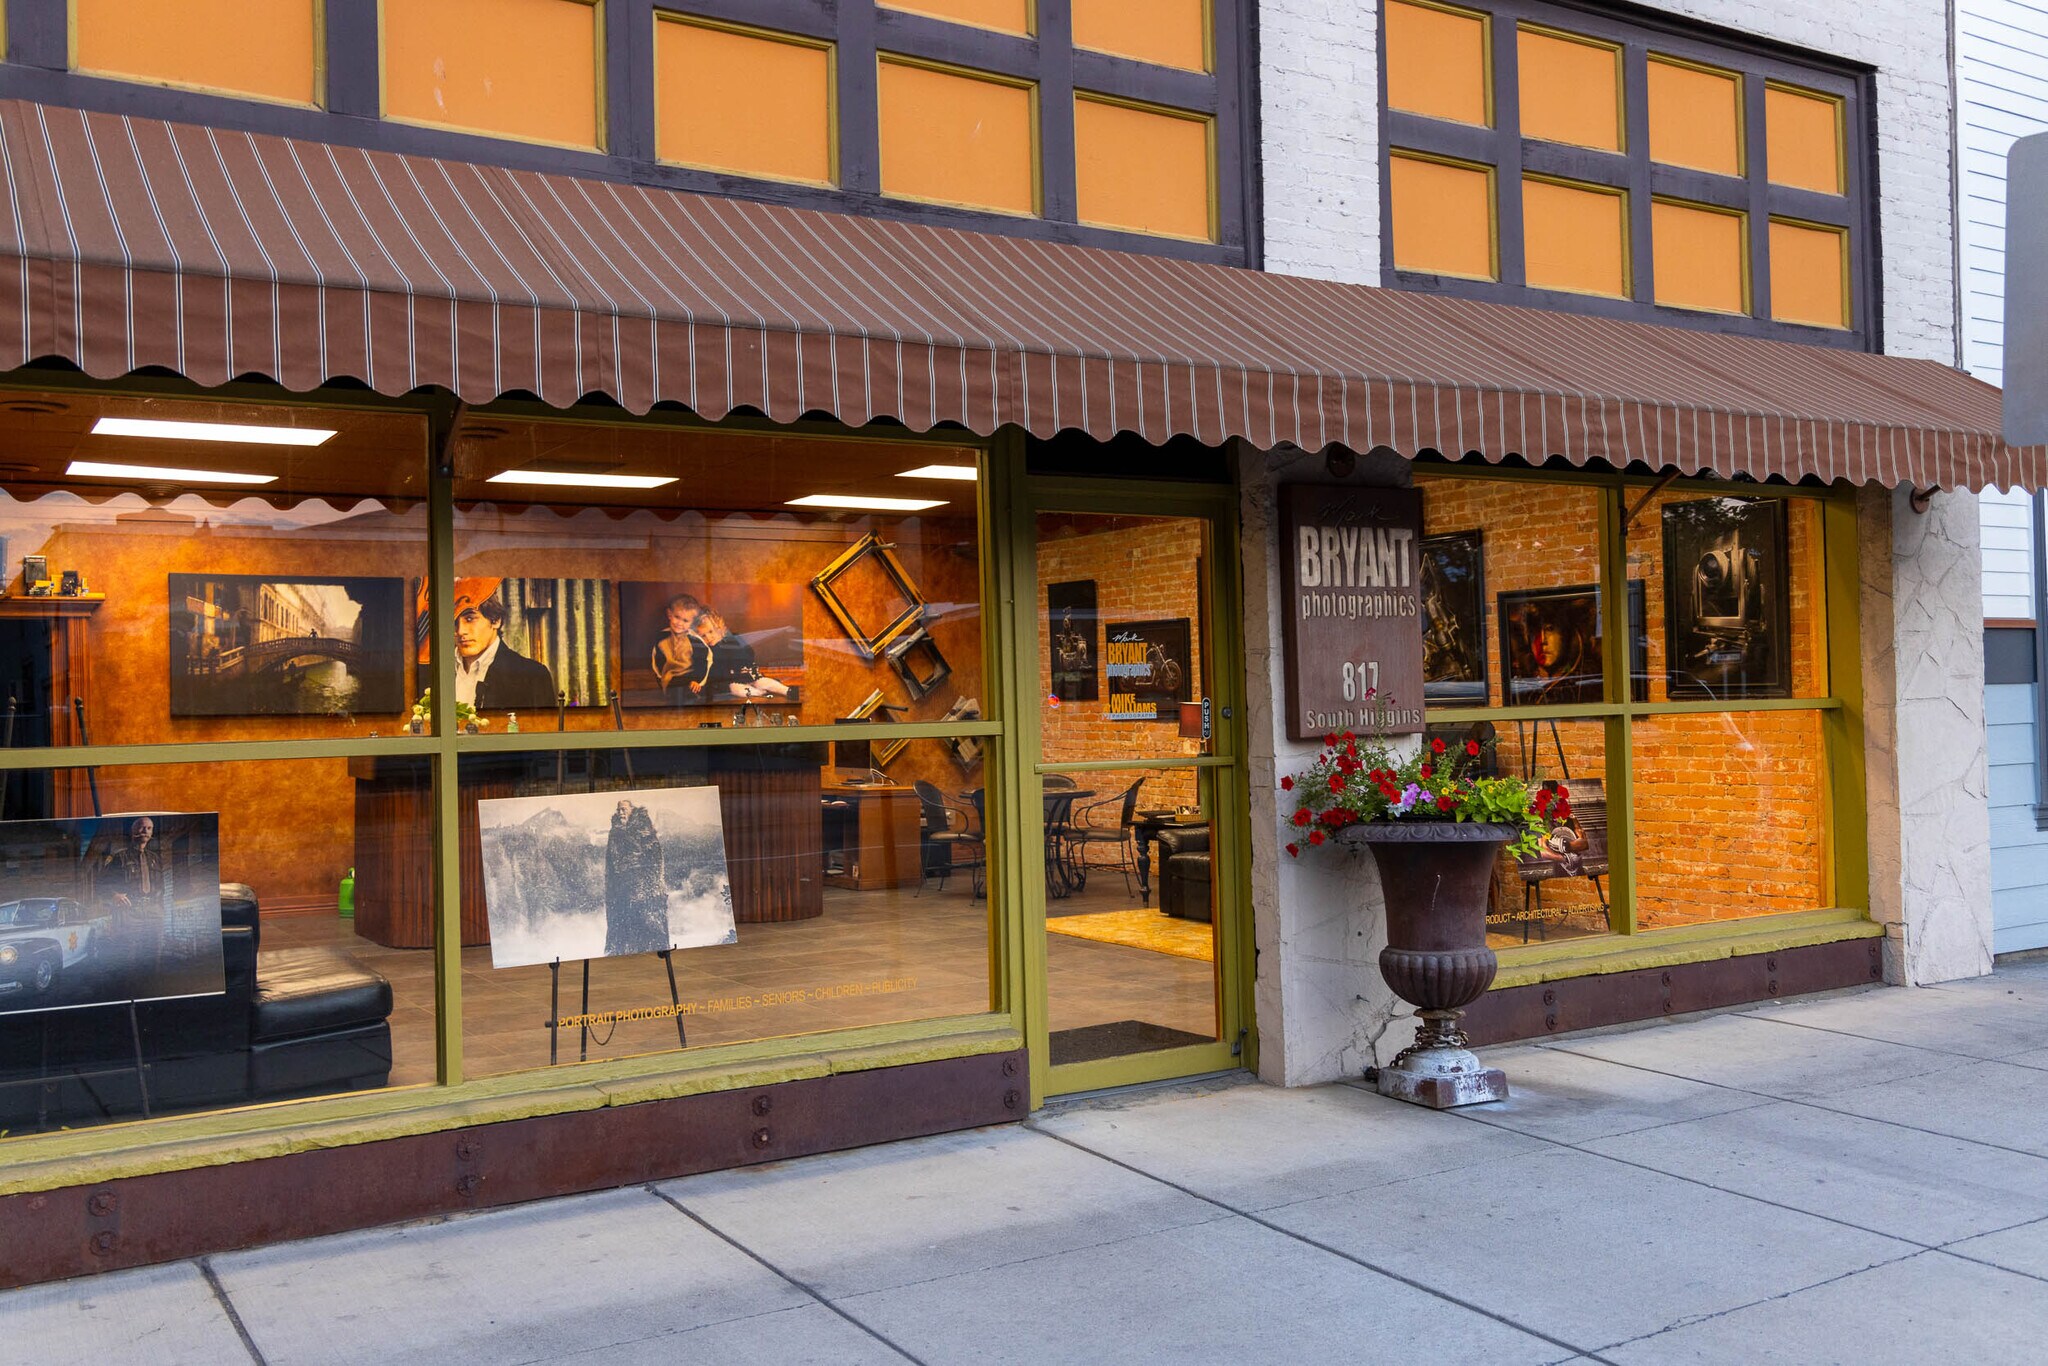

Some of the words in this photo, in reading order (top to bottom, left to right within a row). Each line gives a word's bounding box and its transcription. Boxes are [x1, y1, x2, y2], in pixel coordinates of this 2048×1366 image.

[1300, 525, 1413, 588] BRYANT
[1302, 591, 1416, 620] photographics
[1107, 642, 1148, 664] BRYANT
[1342, 661, 1380, 702] 817
[1111, 693, 1136, 704] MIKE
[1111, 702, 1157, 713] WILLIAMS
[1306, 708, 1354, 730] South
[1485, 912, 1512, 925] RODUCT
[1516, 907, 1563, 921] ARCHITECTURAL
[1568, 902, 1605, 916] ADVERTISING
[558, 1011, 614, 1029] PORTRAIT
[616, 1003, 697, 1022] PHOTOGRAPHY
[708, 996, 752, 1012] FAMILIES
[762, 989, 806, 1006] SENIORS
[815, 983, 862, 999] CHILDREN
[872, 977, 918, 993] PUBLICITY
